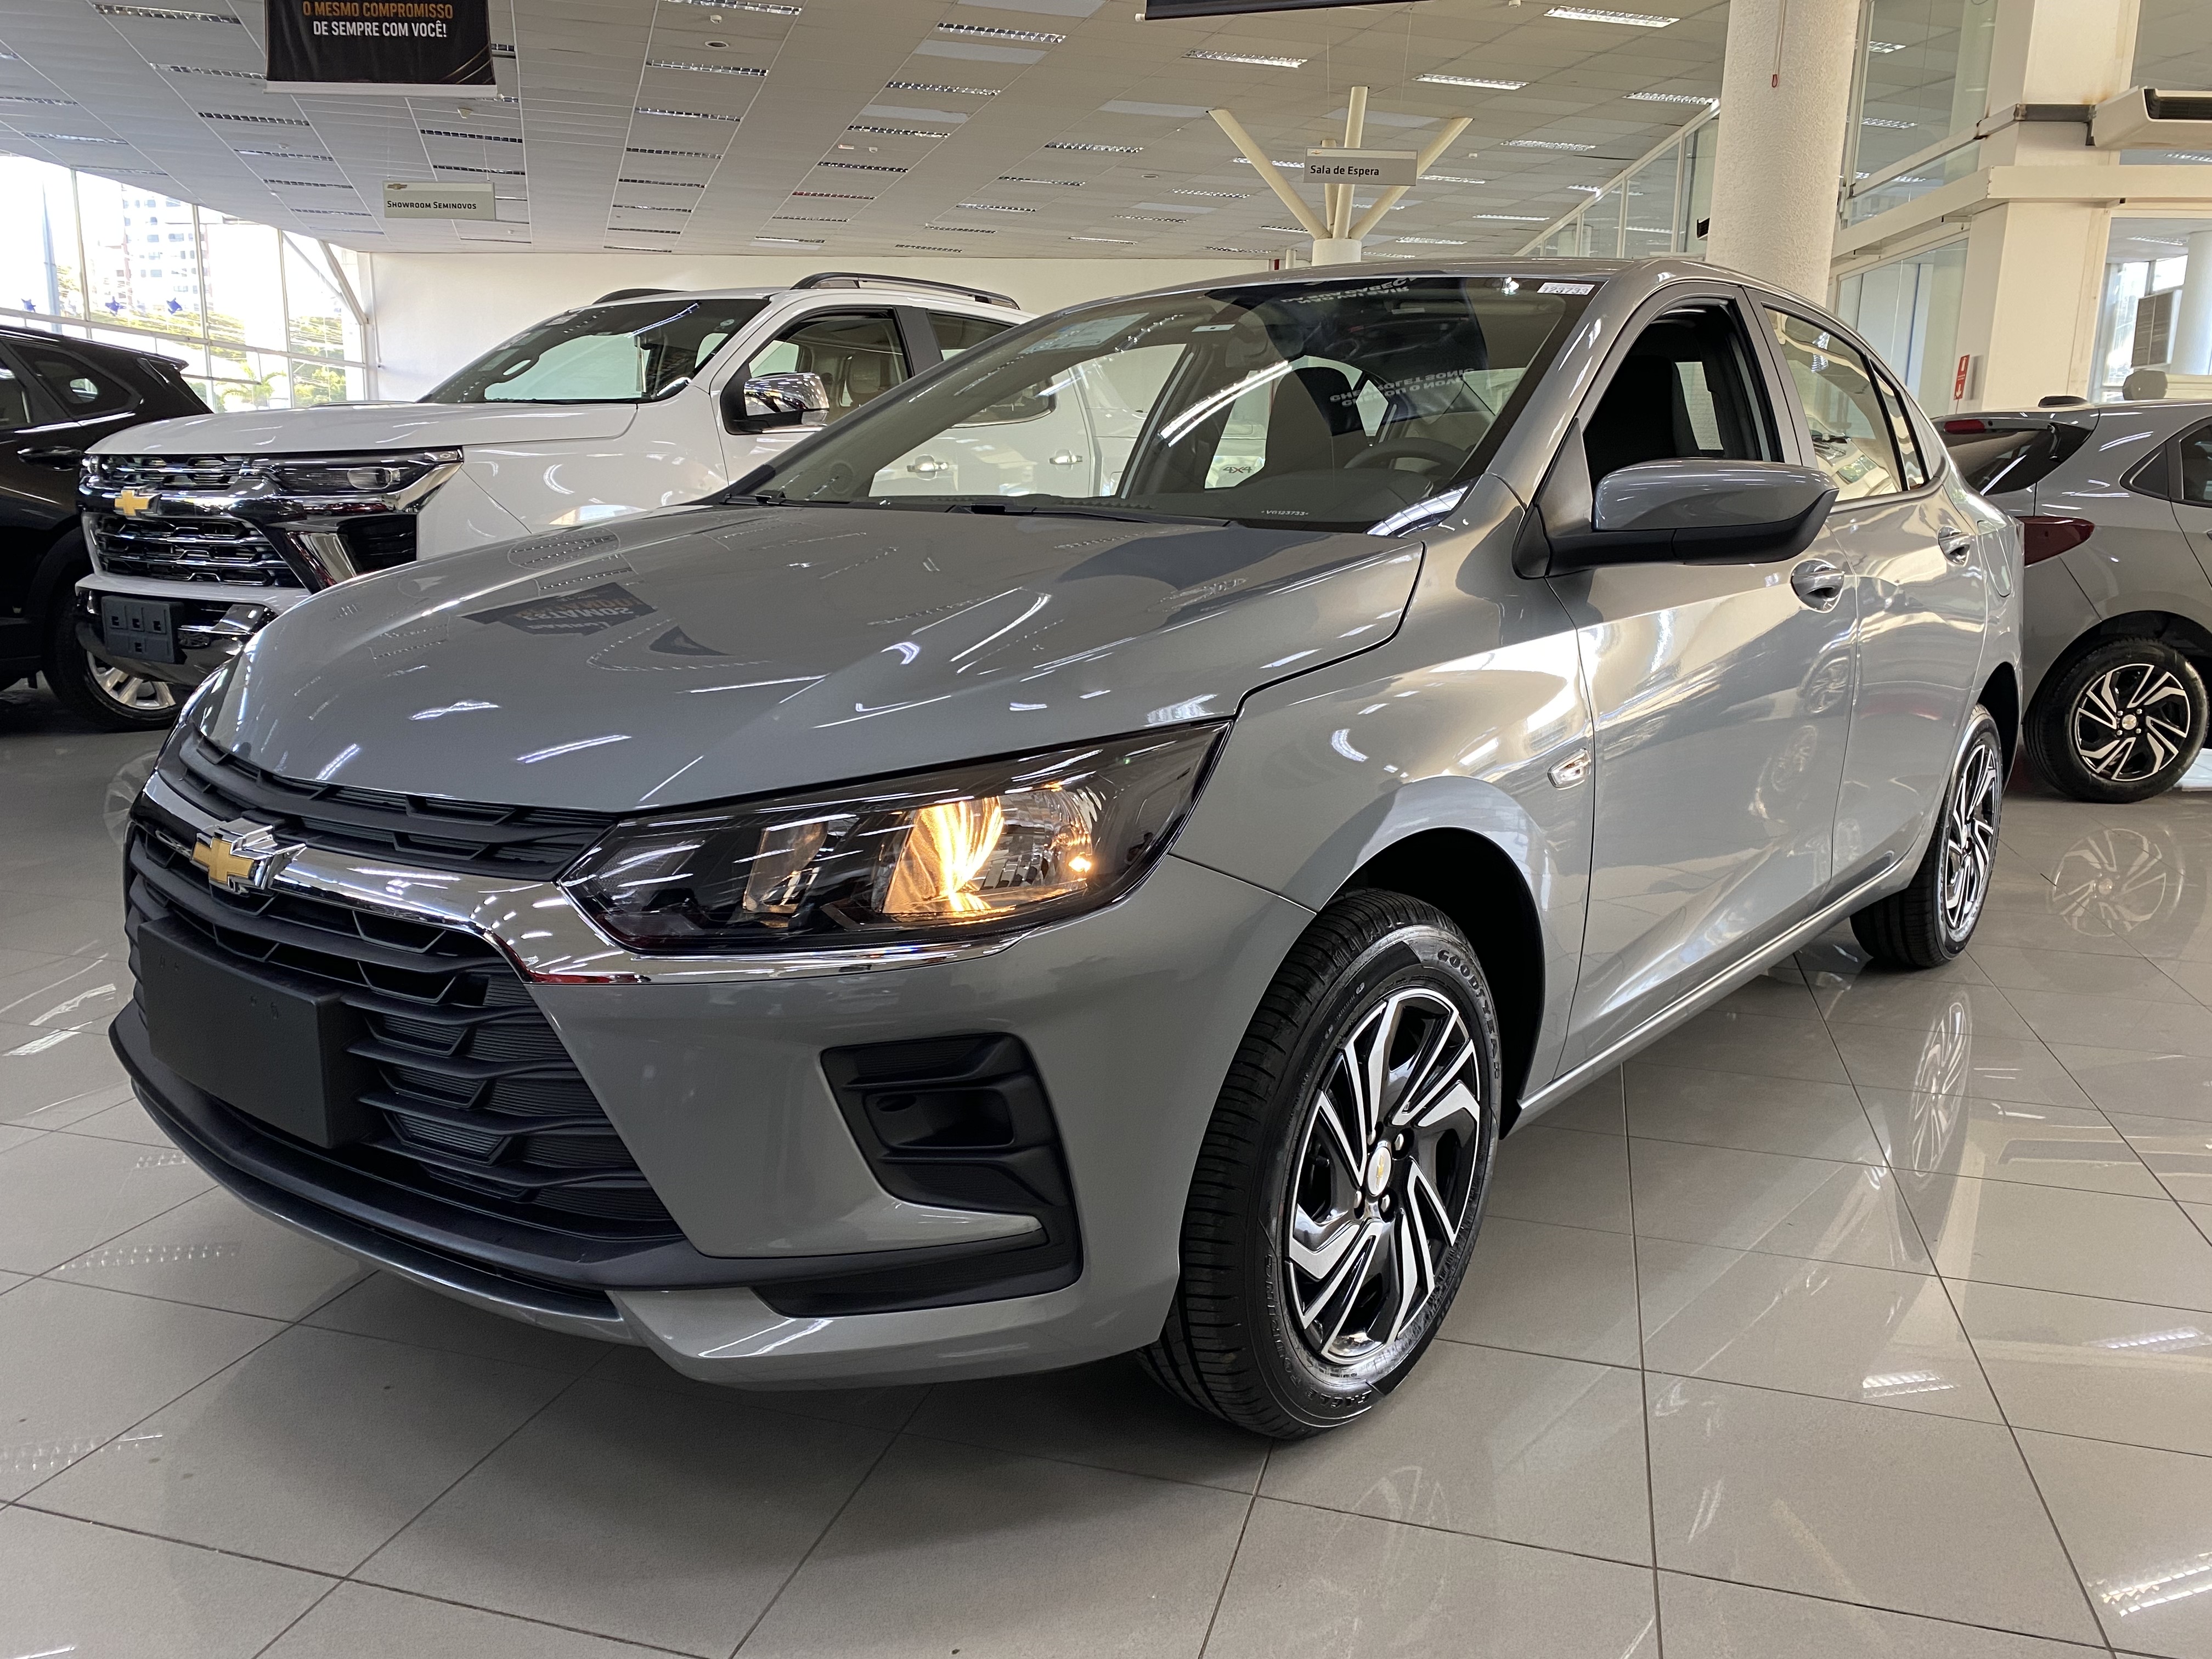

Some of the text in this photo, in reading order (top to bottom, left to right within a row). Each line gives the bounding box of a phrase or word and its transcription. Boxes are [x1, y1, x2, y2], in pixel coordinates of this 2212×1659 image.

[303, 1, 454, 19] O MESMO COMPROMISSO
[313, 20, 447, 37] DE SEMPRE COM VOCÊ!
[1310, 165, 1379, 177] Sala de Espera
[1437, 950, 1500, 1080] GOODYEAR
